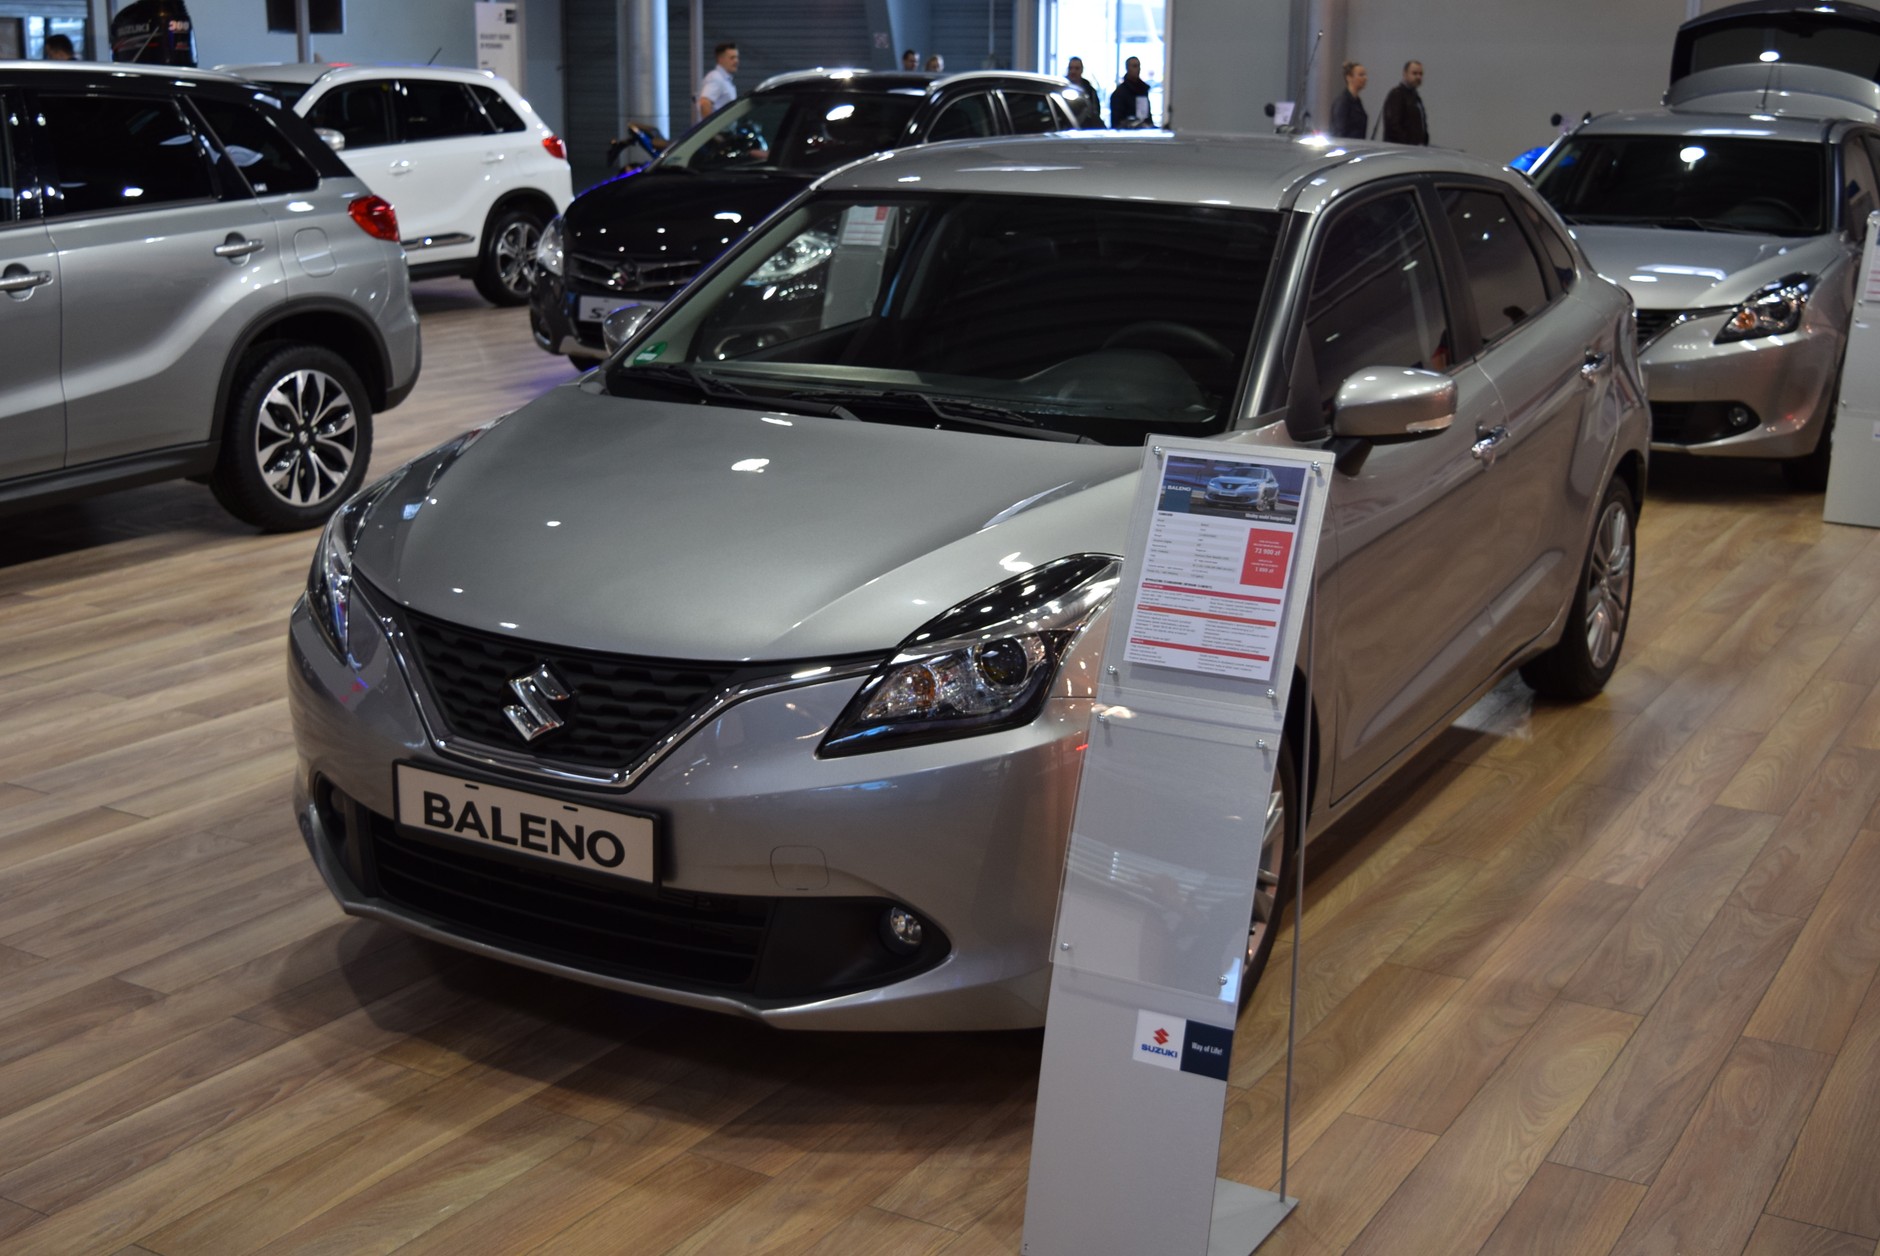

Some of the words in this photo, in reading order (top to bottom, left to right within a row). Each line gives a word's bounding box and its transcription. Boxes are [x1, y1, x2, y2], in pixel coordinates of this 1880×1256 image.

[423, 791, 626, 868] BALENO
[1141, 1043, 1178, 1058] SUZUKI
[1191, 1041, 1204, 1053] Way
[1203, 1045, 1211, 1053] of
